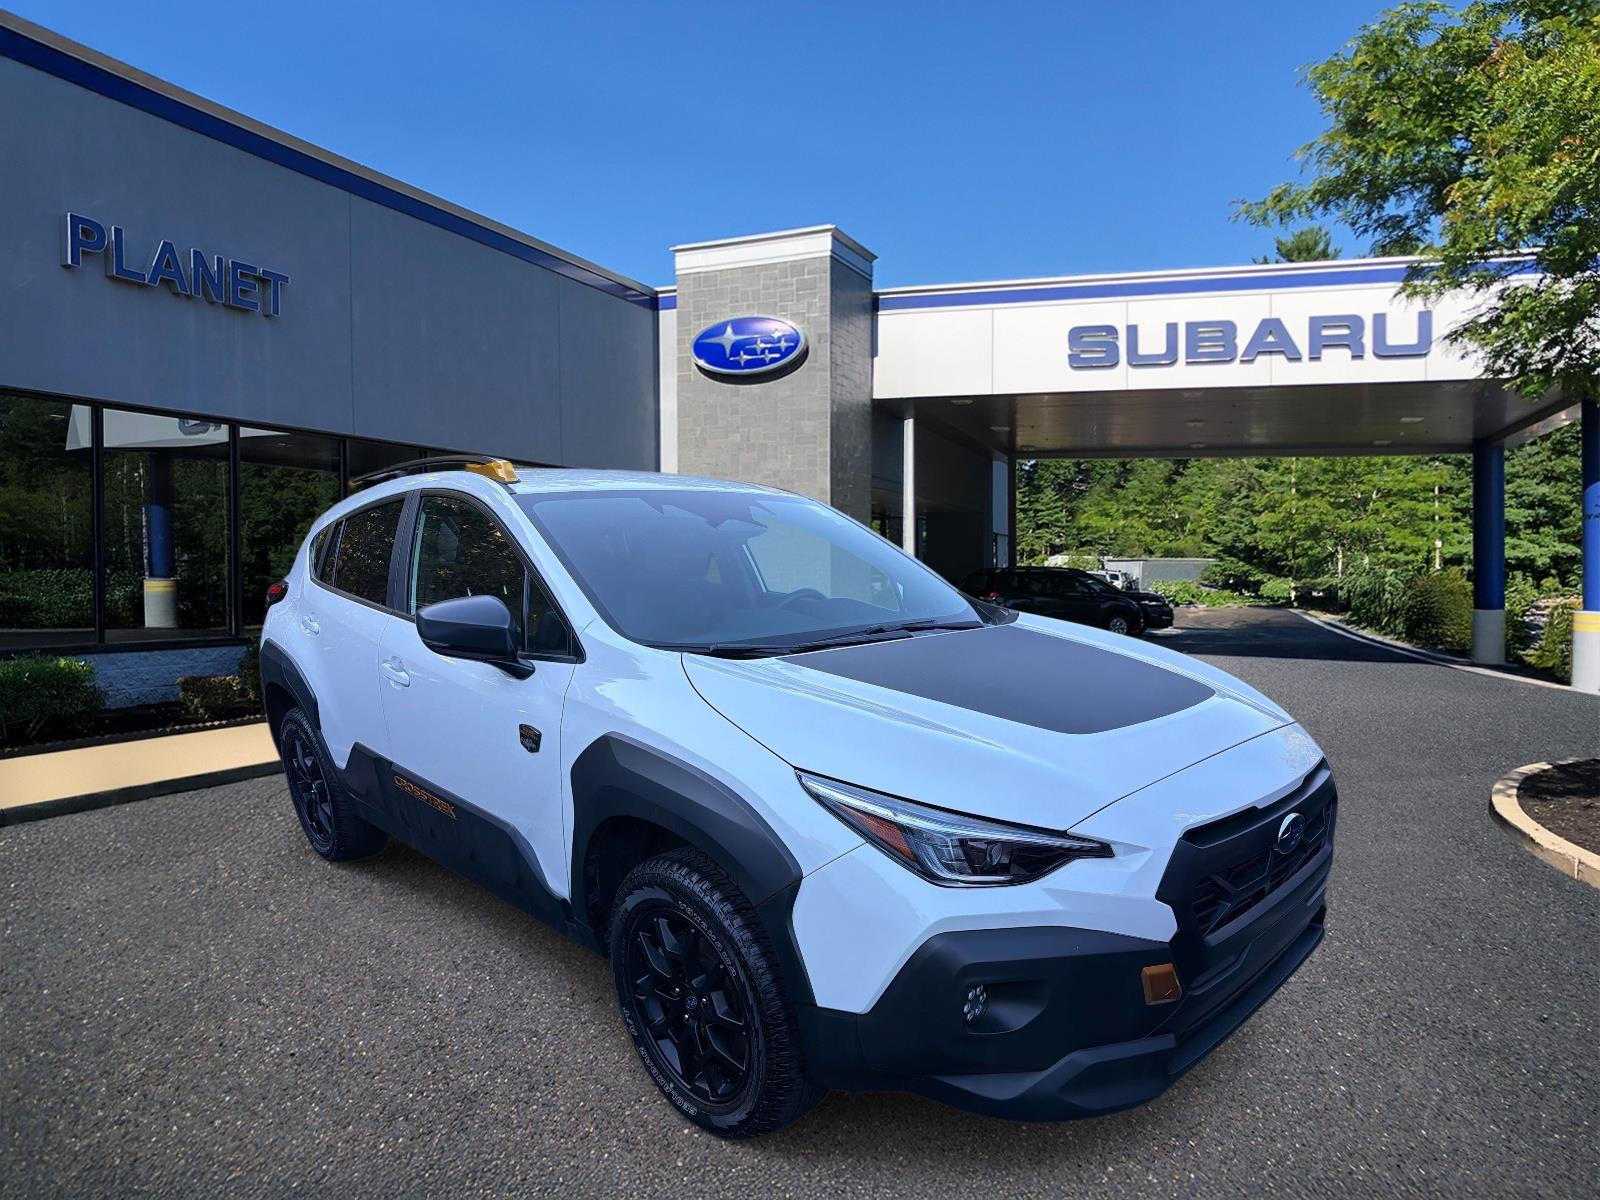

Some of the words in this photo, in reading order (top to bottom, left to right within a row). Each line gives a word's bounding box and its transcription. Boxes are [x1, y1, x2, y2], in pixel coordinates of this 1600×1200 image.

[62, 212, 290, 317] PLANET
[1068, 310, 1432, 369] SUBARU
[393, 775, 457, 819] CROSSTREK
[638, 1046, 698, 1116] GEOLANDAR
